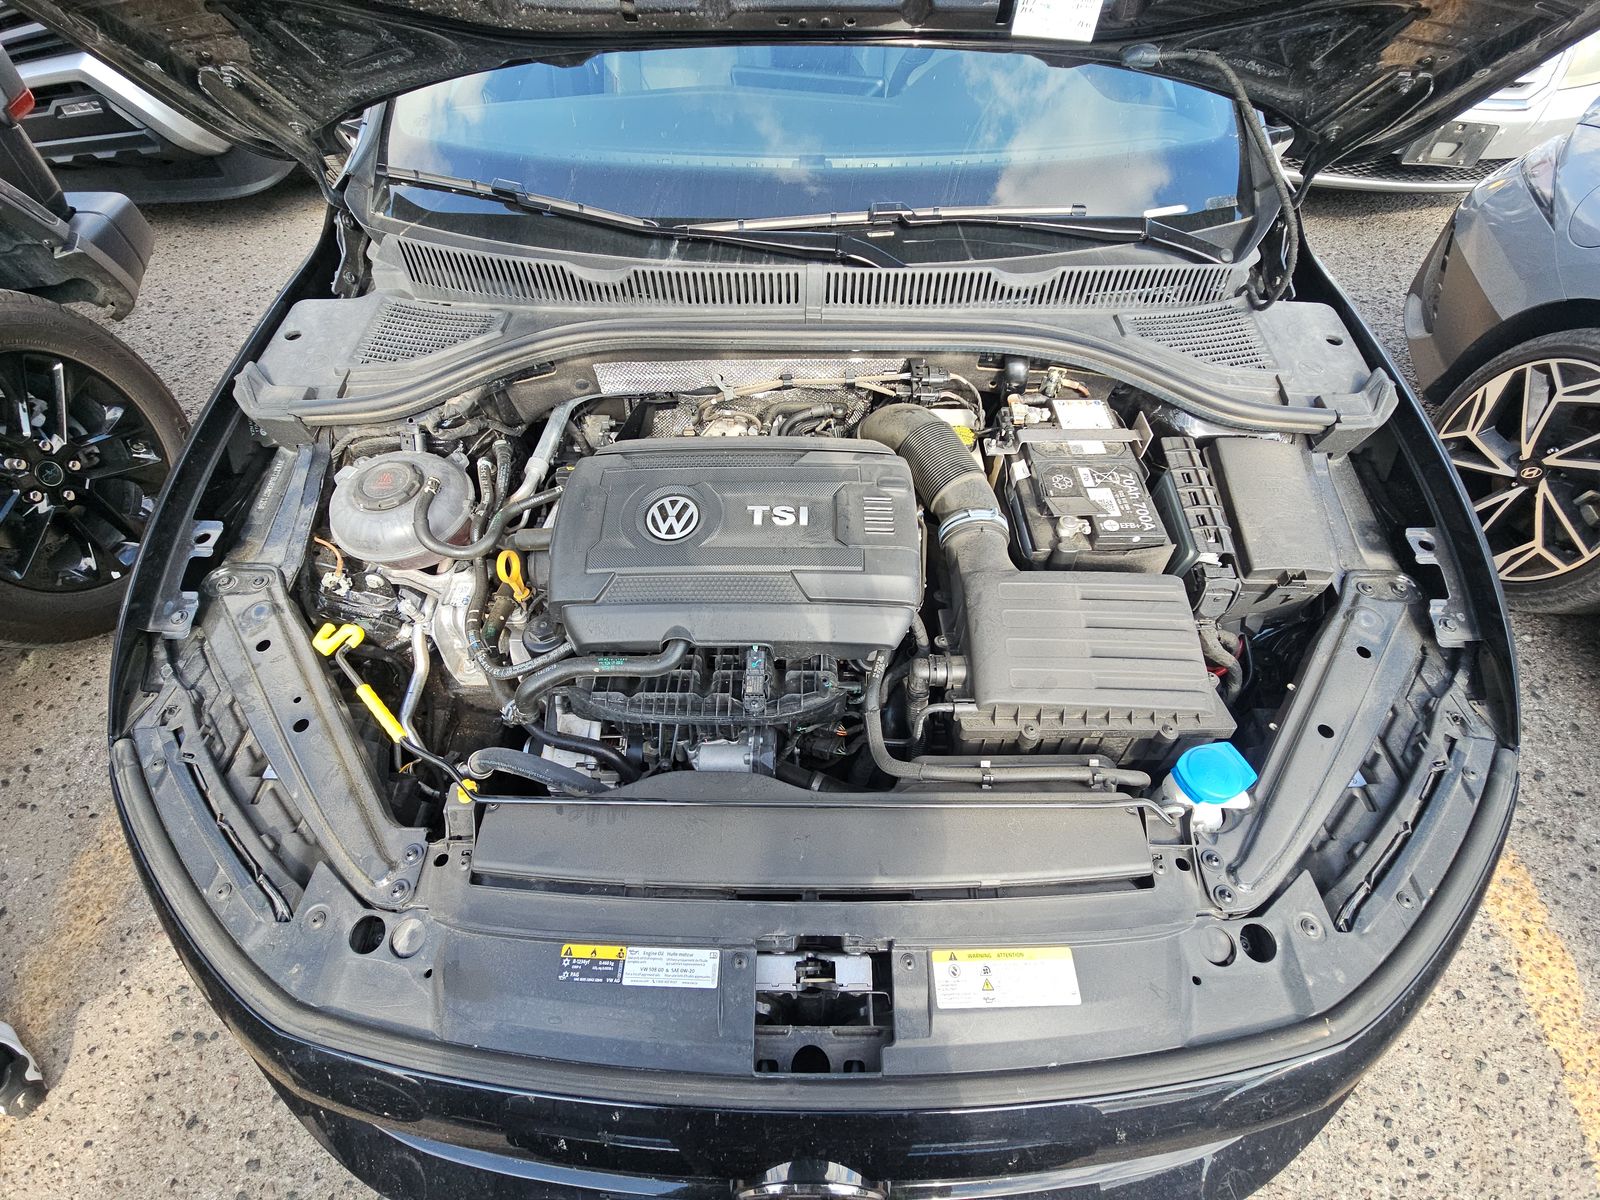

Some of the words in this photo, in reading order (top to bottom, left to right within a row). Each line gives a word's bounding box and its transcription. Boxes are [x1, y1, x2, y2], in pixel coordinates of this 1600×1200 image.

[646, 495, 699, 540] VW
[747, 505, 809, 526] TSI
[1120, 472, 1141, 500] 70Ah
[1132, 502, 1156, 532] 700A
